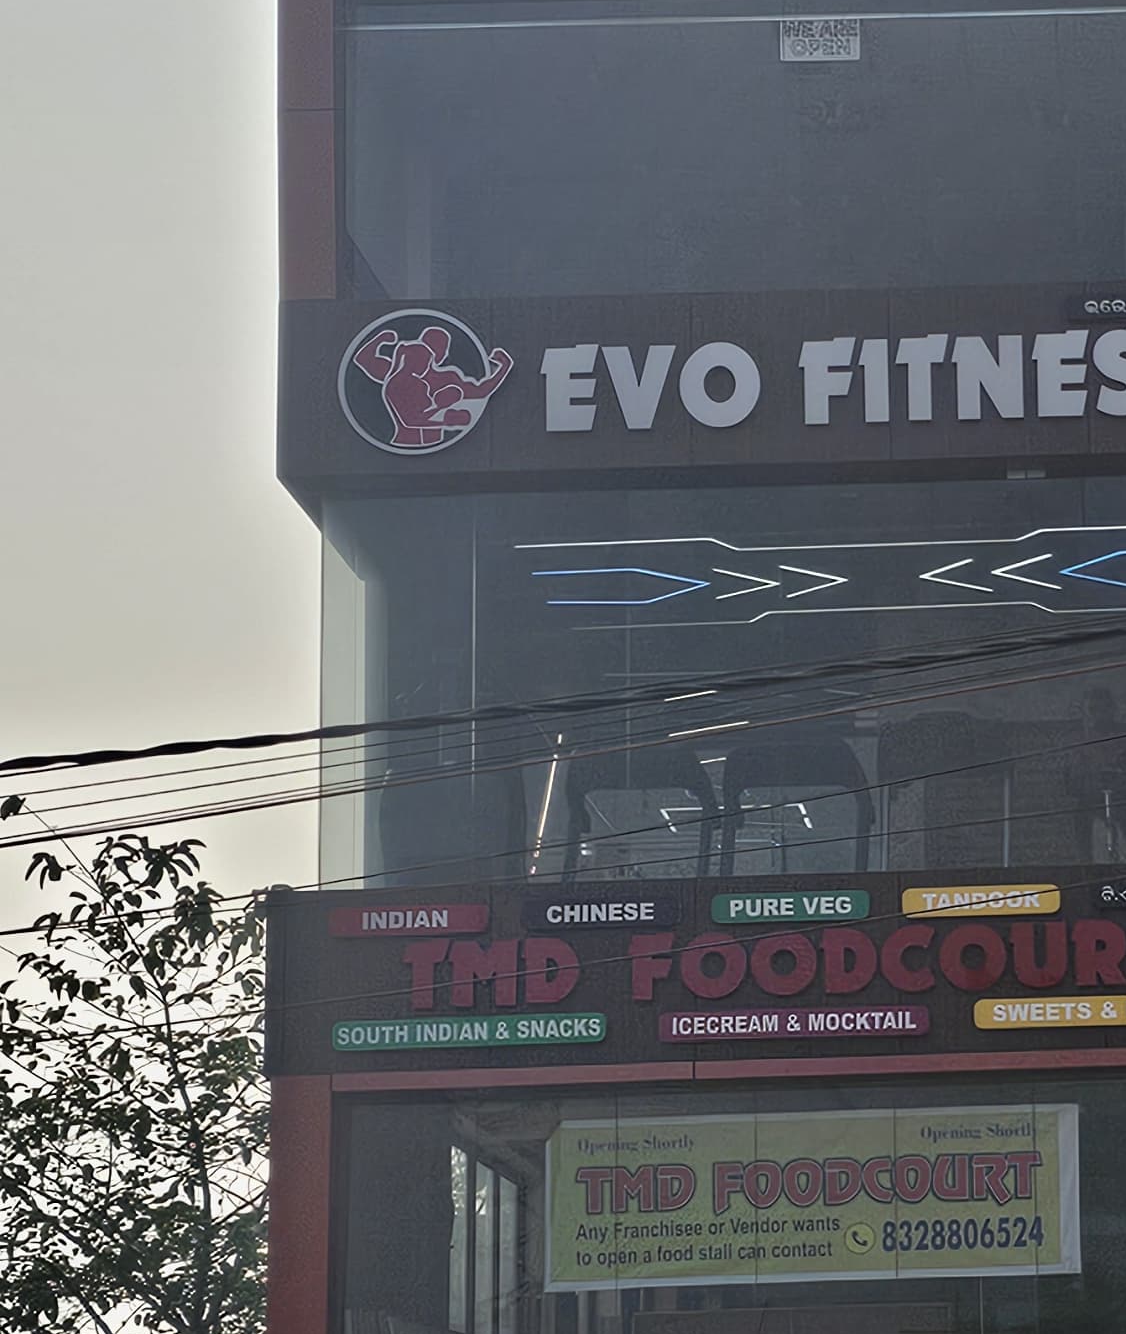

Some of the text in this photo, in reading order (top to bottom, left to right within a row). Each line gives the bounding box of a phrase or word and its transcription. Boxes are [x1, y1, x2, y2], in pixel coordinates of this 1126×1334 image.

[791, 38, 852, 56] OPEN
[540, 340, 761, 432] EVO
[546, 902, 655, 924] CHINESE
[729, 895, 852, 918] PURE VEG
[361, 909, 449, 932] INDIAN
[404, 936, 580, 1010] TMD
[672, 1010, 917, 1036] ICECREAM & MOCKTAIL
[992, 1002, 1092, 1023] SWEETS
[1101, 1000, 1118, 1019] &
[336, 1017, 601, 1046] SOUTH INDIAN & SNACKS
[577, 1132, 695, 1154] Opening Shortly
[920, 1124, 983, 1144] Opening
[576, 1151, 1042, 1216] TMD FOODCOURT
[576, 1215, 840, 1245] Any Franchisee or Vendor wants
[882, 1215, 1044, 1253] 8328806524
[576, 1240, 833, 1270] to open a food stall can contact
